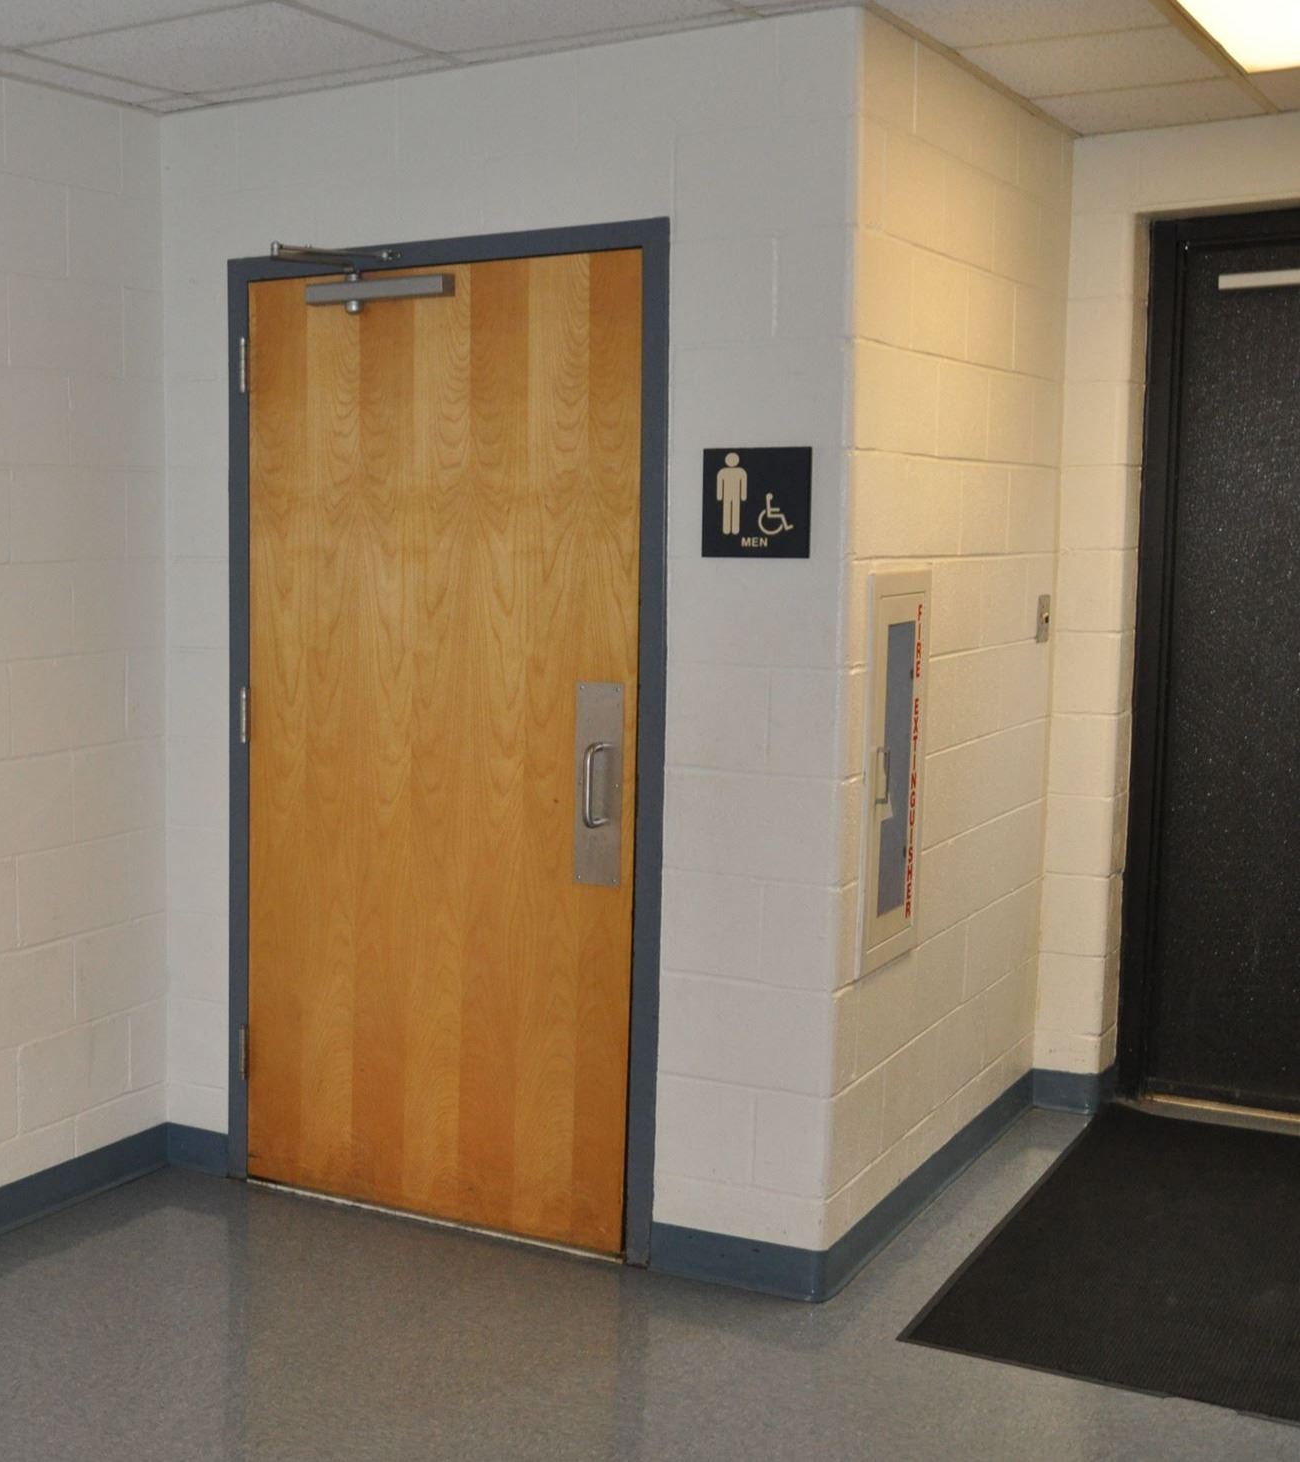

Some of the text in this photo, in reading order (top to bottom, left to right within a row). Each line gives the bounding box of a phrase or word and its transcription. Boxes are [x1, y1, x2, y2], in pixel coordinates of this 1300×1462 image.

[741, 537, 768, 548] MEN
[904, 603, 923, 919] FIRE EXTINGUISHER
